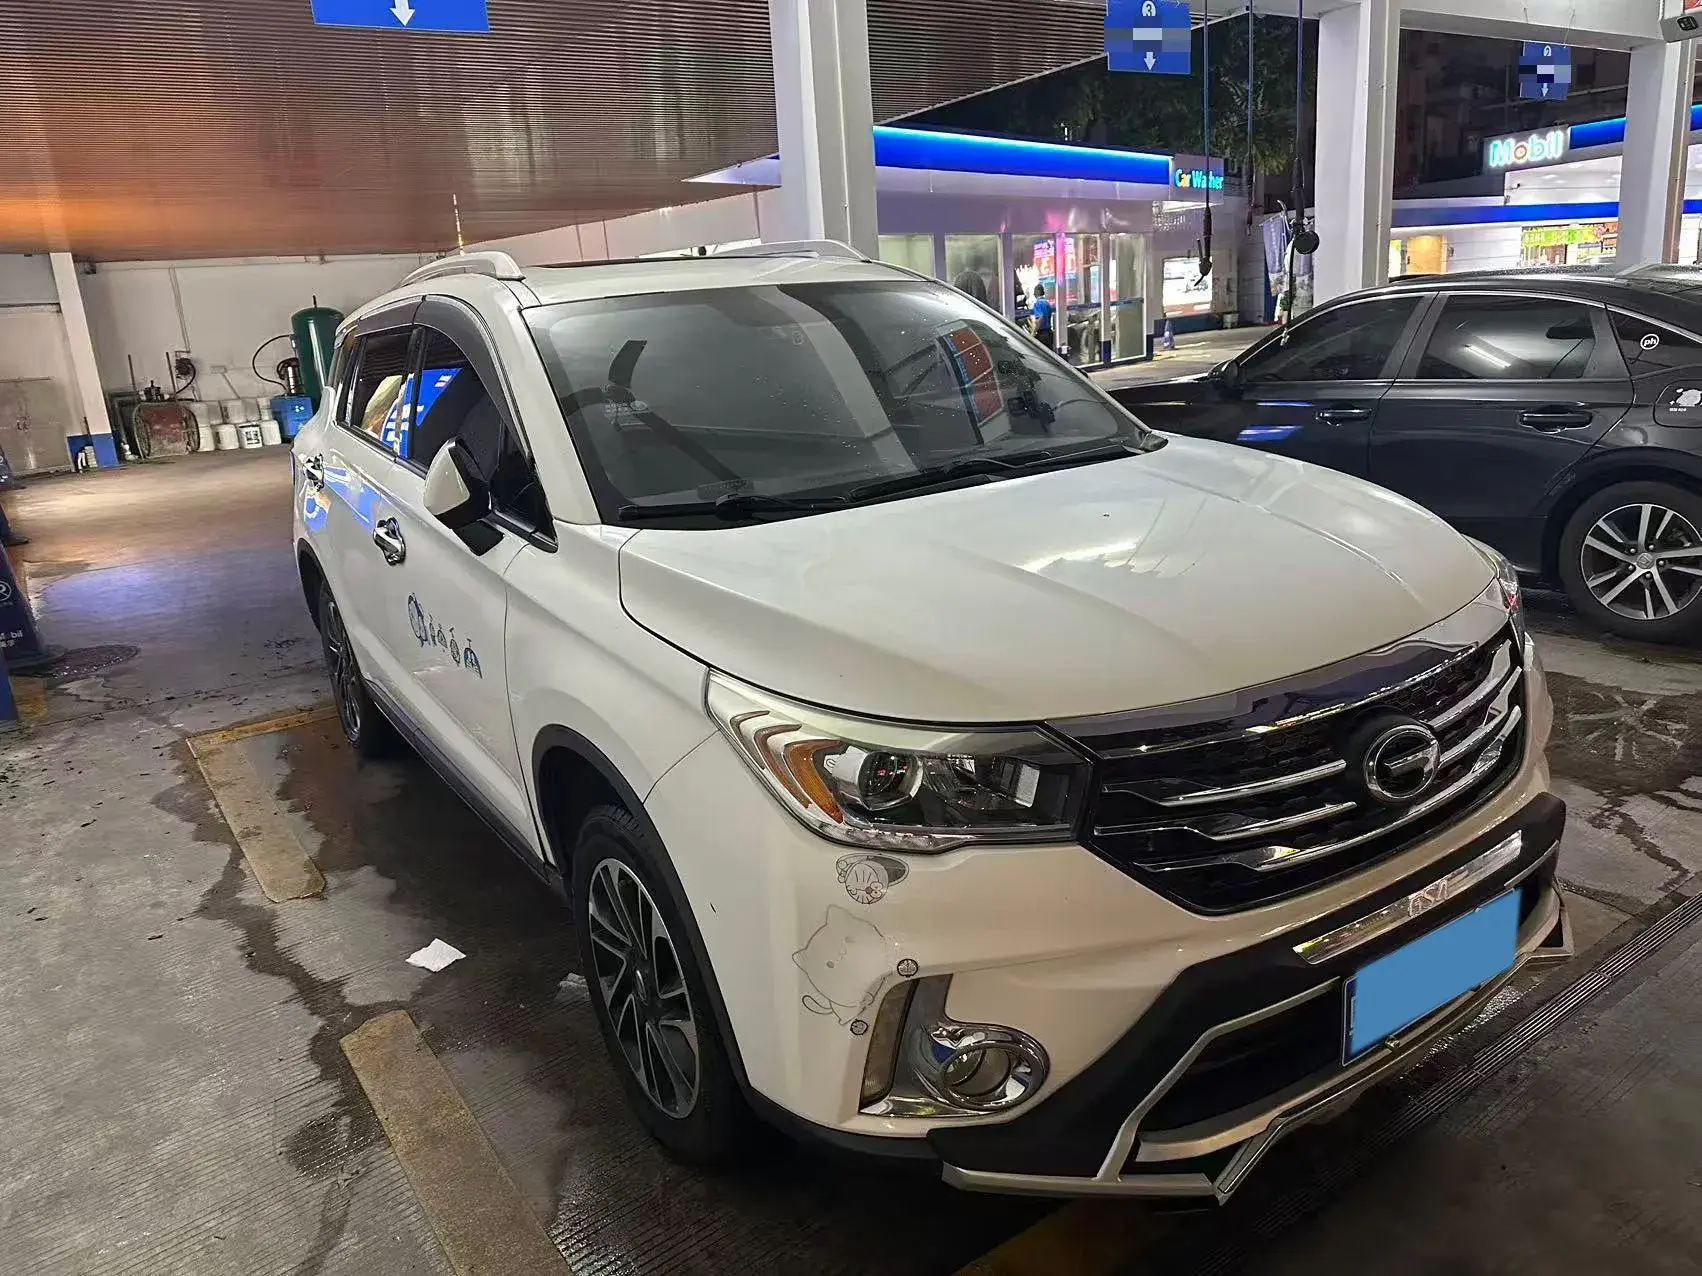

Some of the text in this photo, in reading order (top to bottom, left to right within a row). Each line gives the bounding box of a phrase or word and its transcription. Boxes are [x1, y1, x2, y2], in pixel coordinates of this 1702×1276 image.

[1489, 131, 1563, 167] Mobil
[1176, 168, 1224, 189] Car Waher
[1643, 337, 1657, 346] ph
